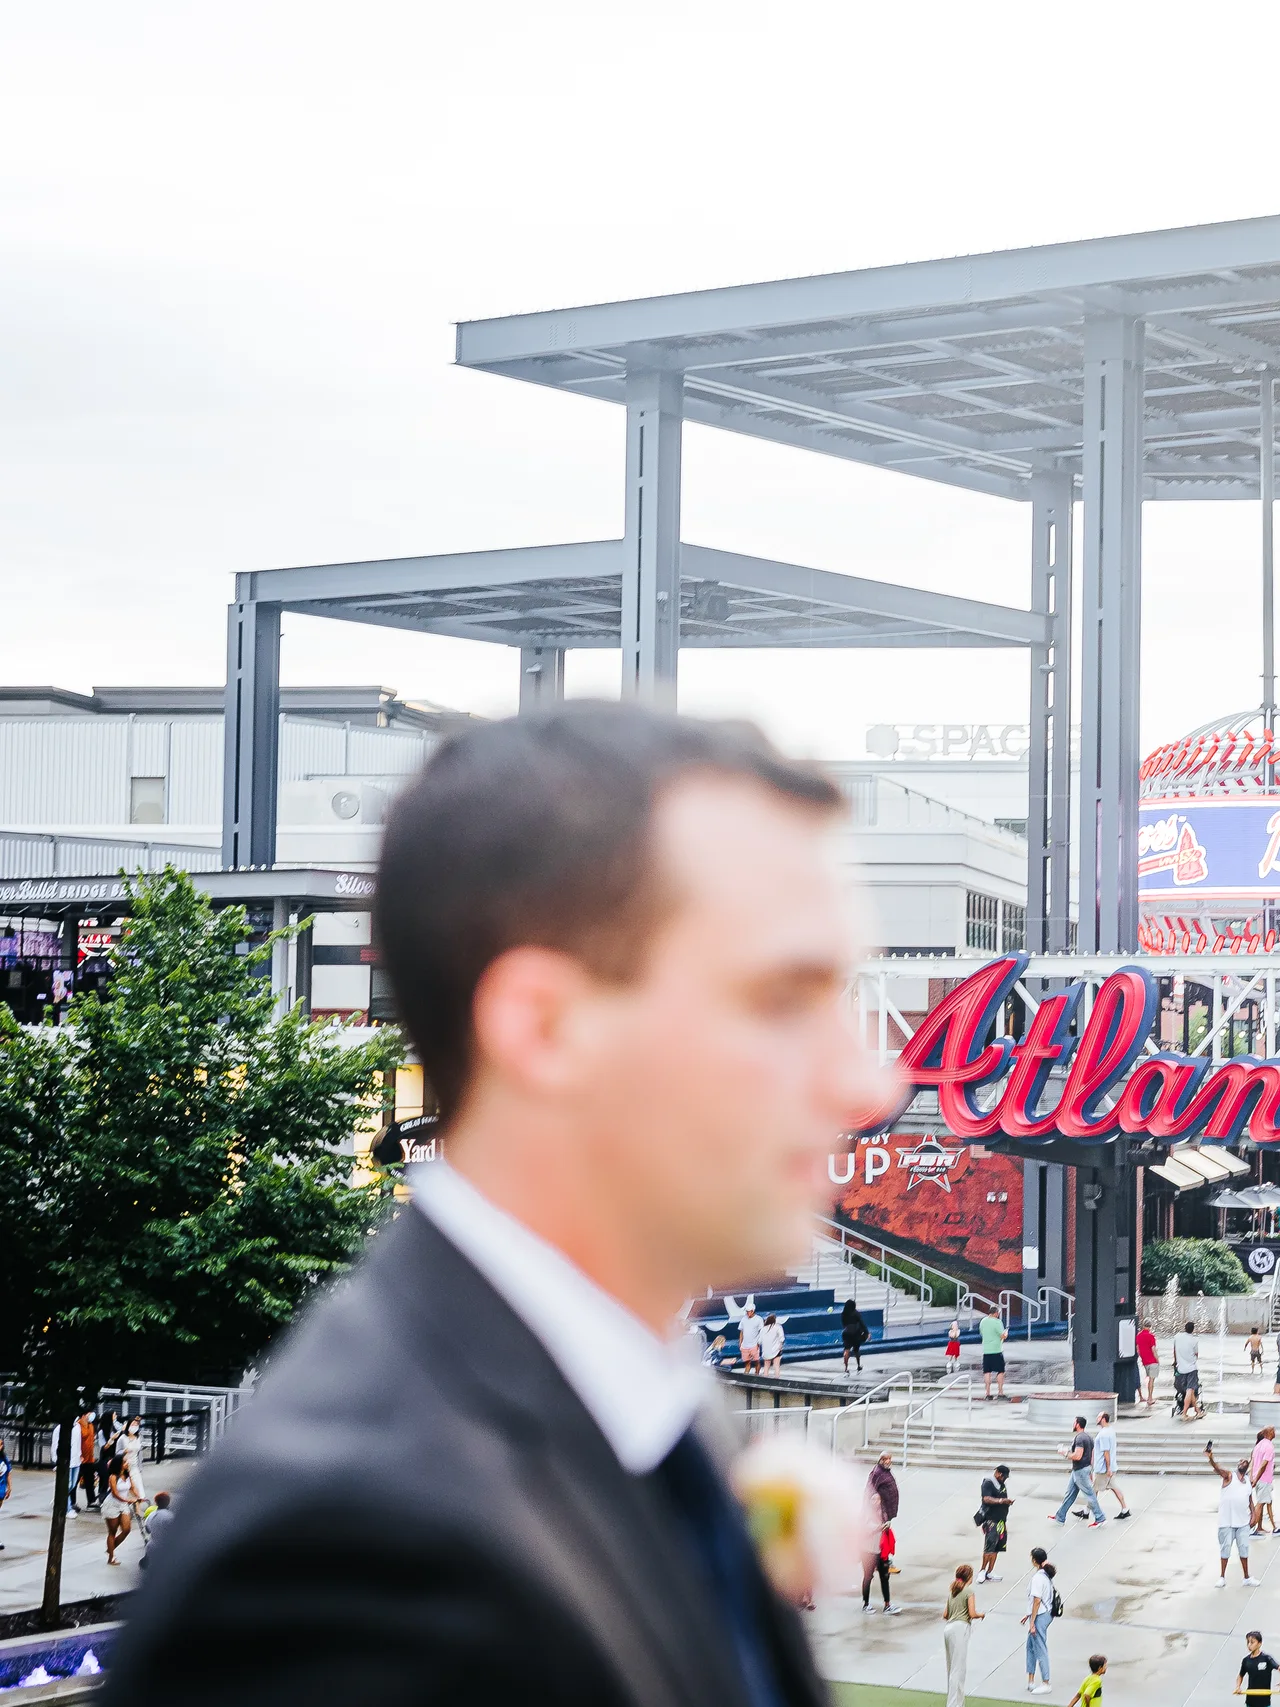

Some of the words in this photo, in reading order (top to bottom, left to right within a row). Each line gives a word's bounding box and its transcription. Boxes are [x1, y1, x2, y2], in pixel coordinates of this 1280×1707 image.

[904, 724, 1027, 758] SPAC
[1138, 813, 1179, 857] ves
[17, 880, 59, 901] Bullet
[59, 884, 107, 899] BRIDGE
[399, 1138, 436, 1163] Yard
[828, 1147, 891, 1185] UP
